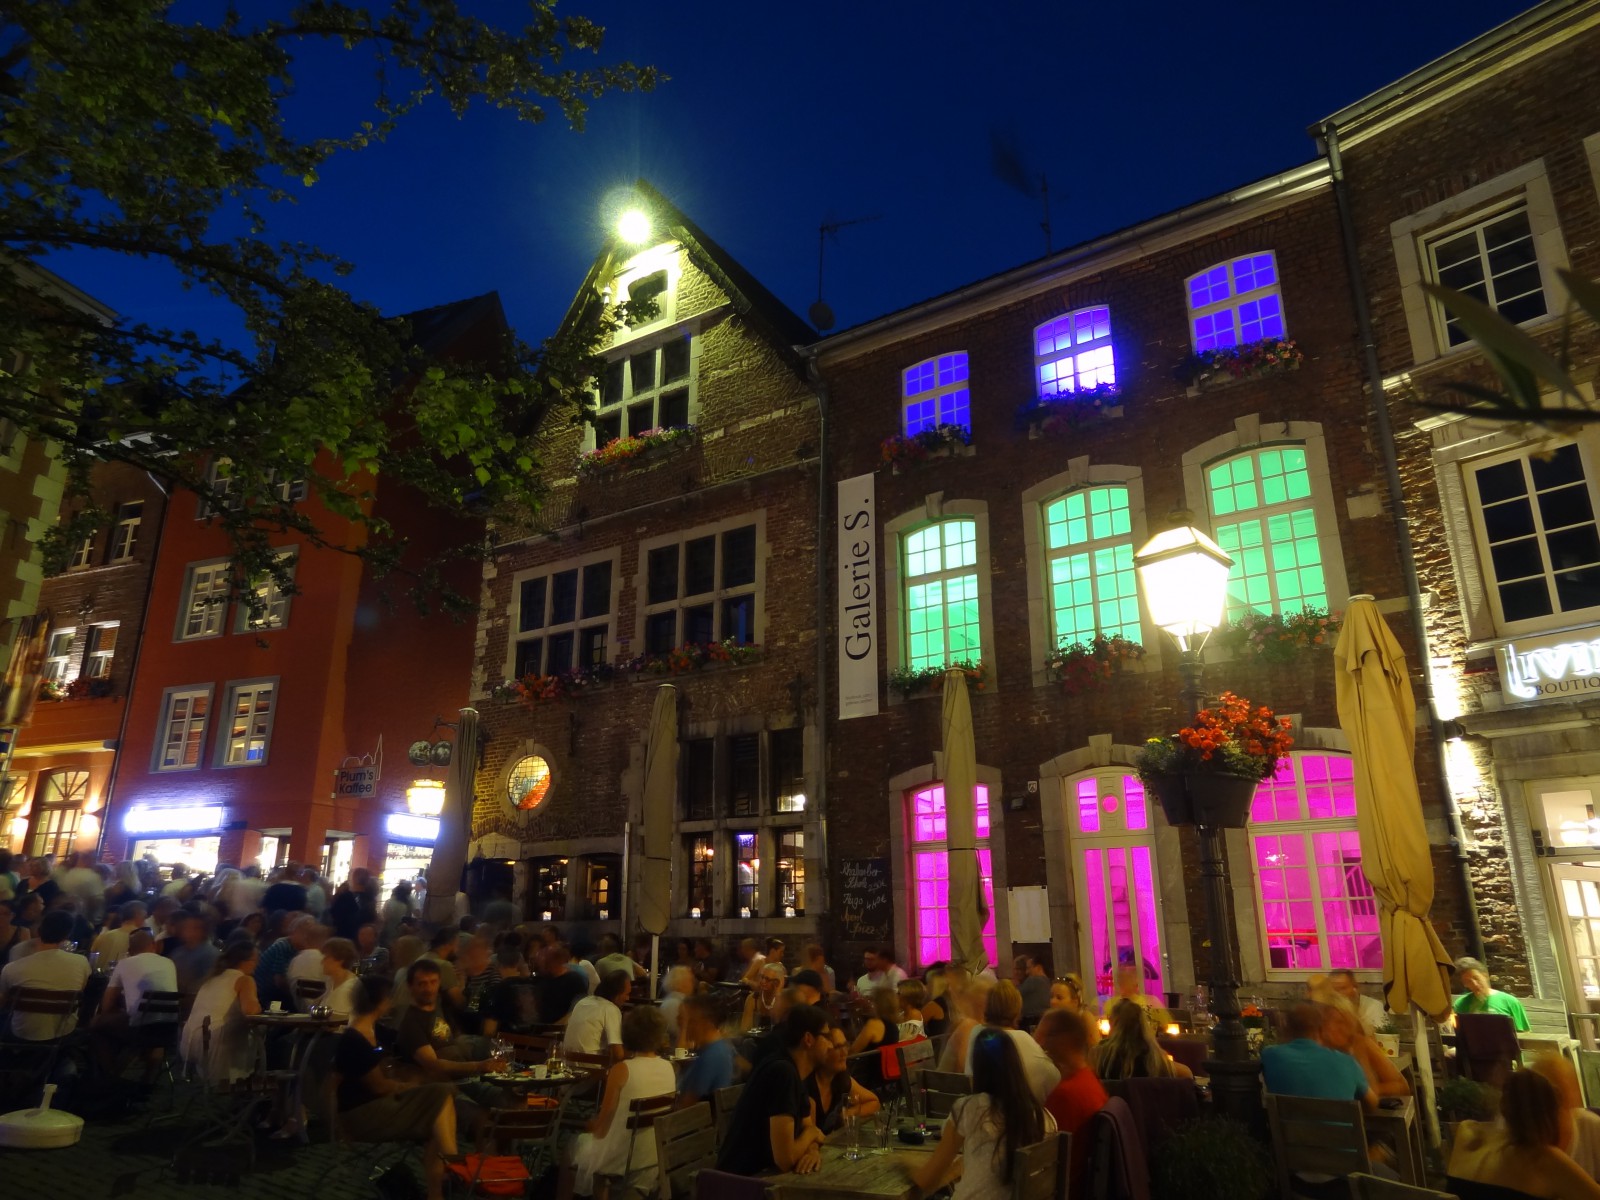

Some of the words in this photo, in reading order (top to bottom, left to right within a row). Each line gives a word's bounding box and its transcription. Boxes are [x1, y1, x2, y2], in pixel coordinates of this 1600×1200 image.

[843, 498, 870, 531] S.
[844, 540, 872, 660] Galerie
[340, 769, 374, 782] Plum's
[339, 782, 372, 794] Kaffee
